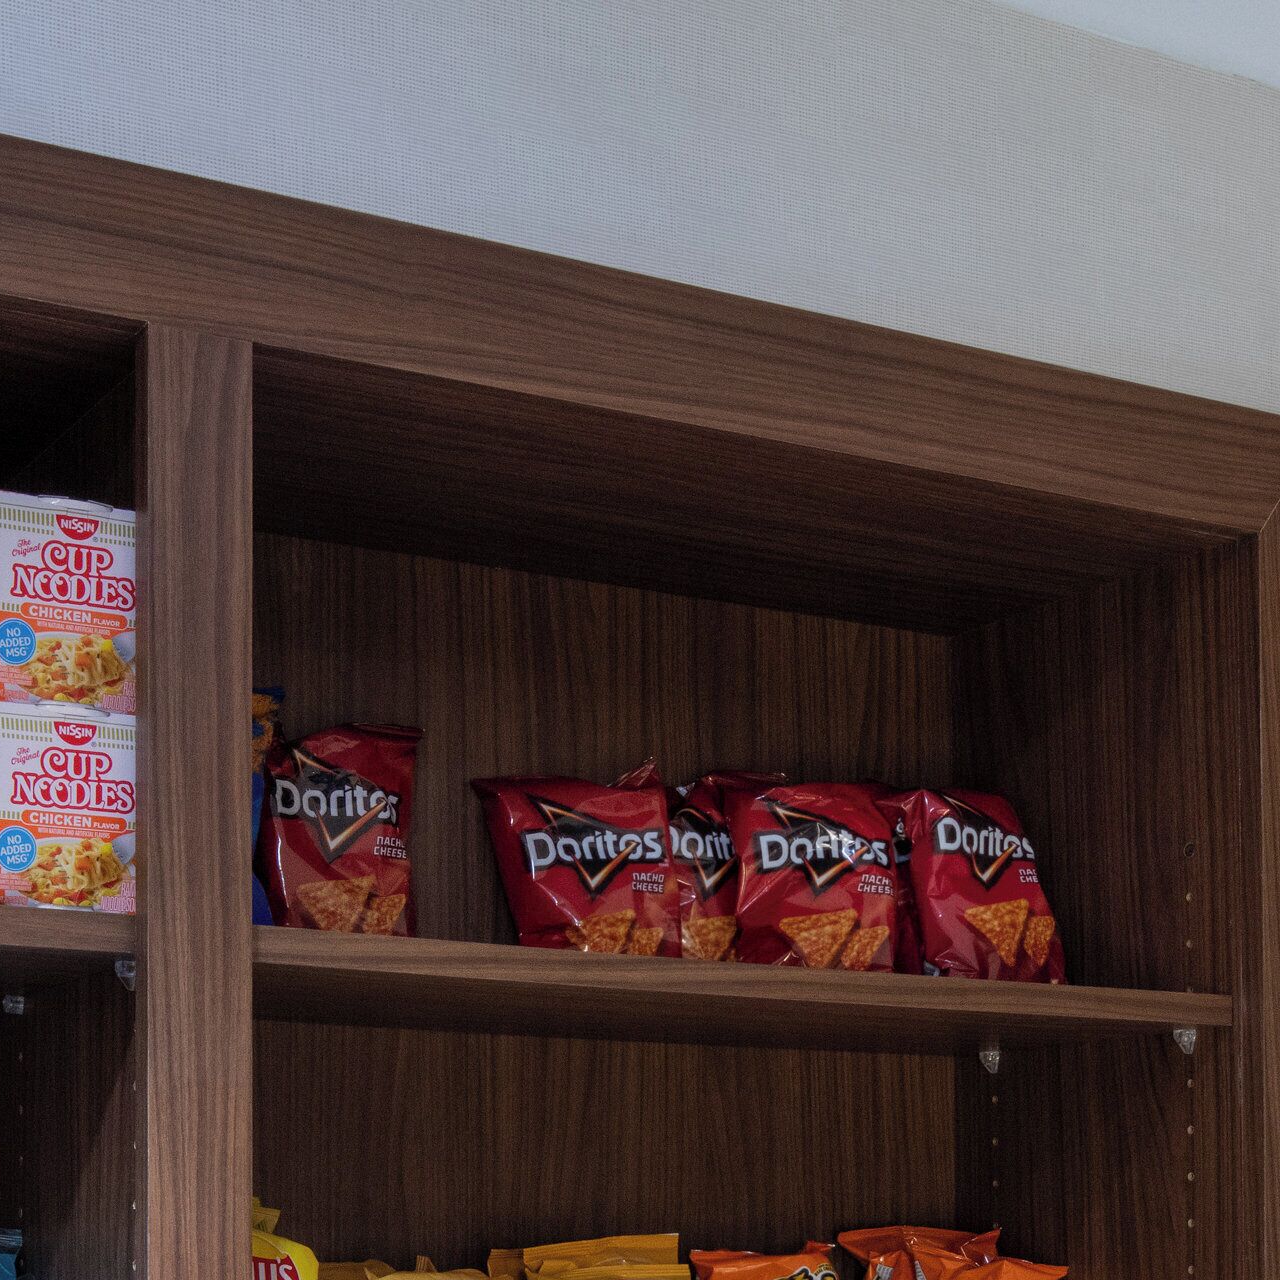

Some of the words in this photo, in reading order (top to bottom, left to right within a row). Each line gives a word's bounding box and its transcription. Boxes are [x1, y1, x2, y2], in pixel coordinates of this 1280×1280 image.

[61, 518, 94, 533] NISSIN
[41, 540, 113, 577] CUP
[11, 564, 136, 611] NOODLES
[29, 606, 91, 623] CHICKEN
[94, 619, 120, 627] FLAVOR
[59, 724, 92, 738] NISSIN
[41, 747, 112, 780] CUP
[11, 771, 136, 814] NOODLES
[30, 813, 92, 827] CHICKEN
[525, 830, 662, 867] Doritos
[759, 833, 888, 870] Doritos
[938, 817, 1034, 859] Doritos
[632, 873, 664, 883] NACHO
[632, 882, 664, 893] CHEESE
